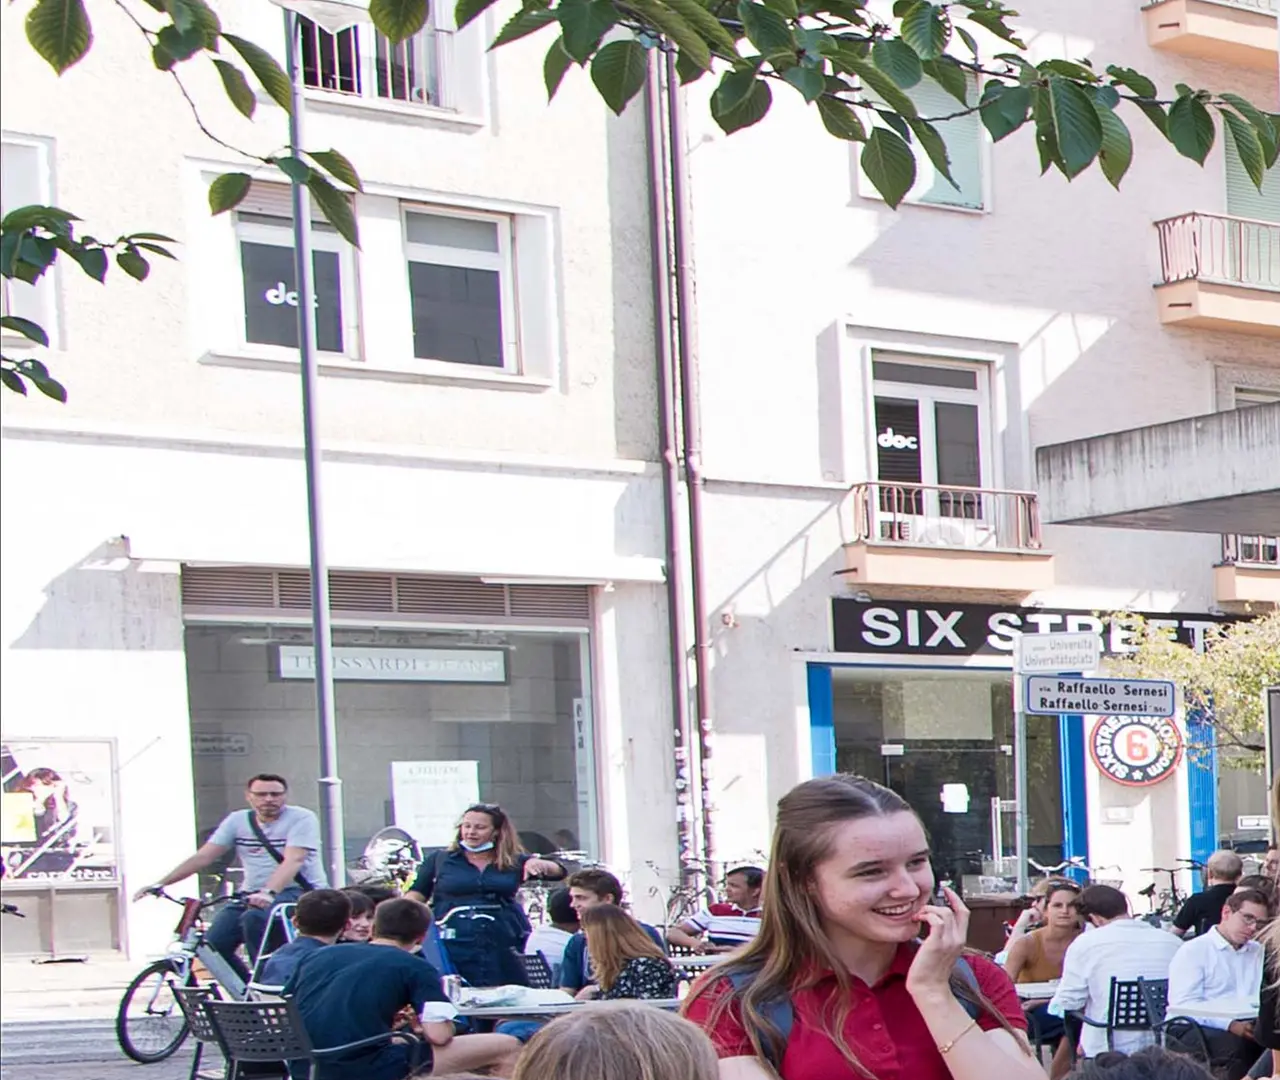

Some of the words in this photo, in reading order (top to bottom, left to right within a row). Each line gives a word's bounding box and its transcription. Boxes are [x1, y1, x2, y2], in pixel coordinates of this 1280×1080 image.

[265, 281, 318, 307] do
[877, 427, 918, 450] doc
[861, 606, 966, 649] SIX
[1058, 682, 1116, 695] Raffaello
[1124, 684, 1167, 697] Sernesi
[1126, 730, 1150, 762] 6
